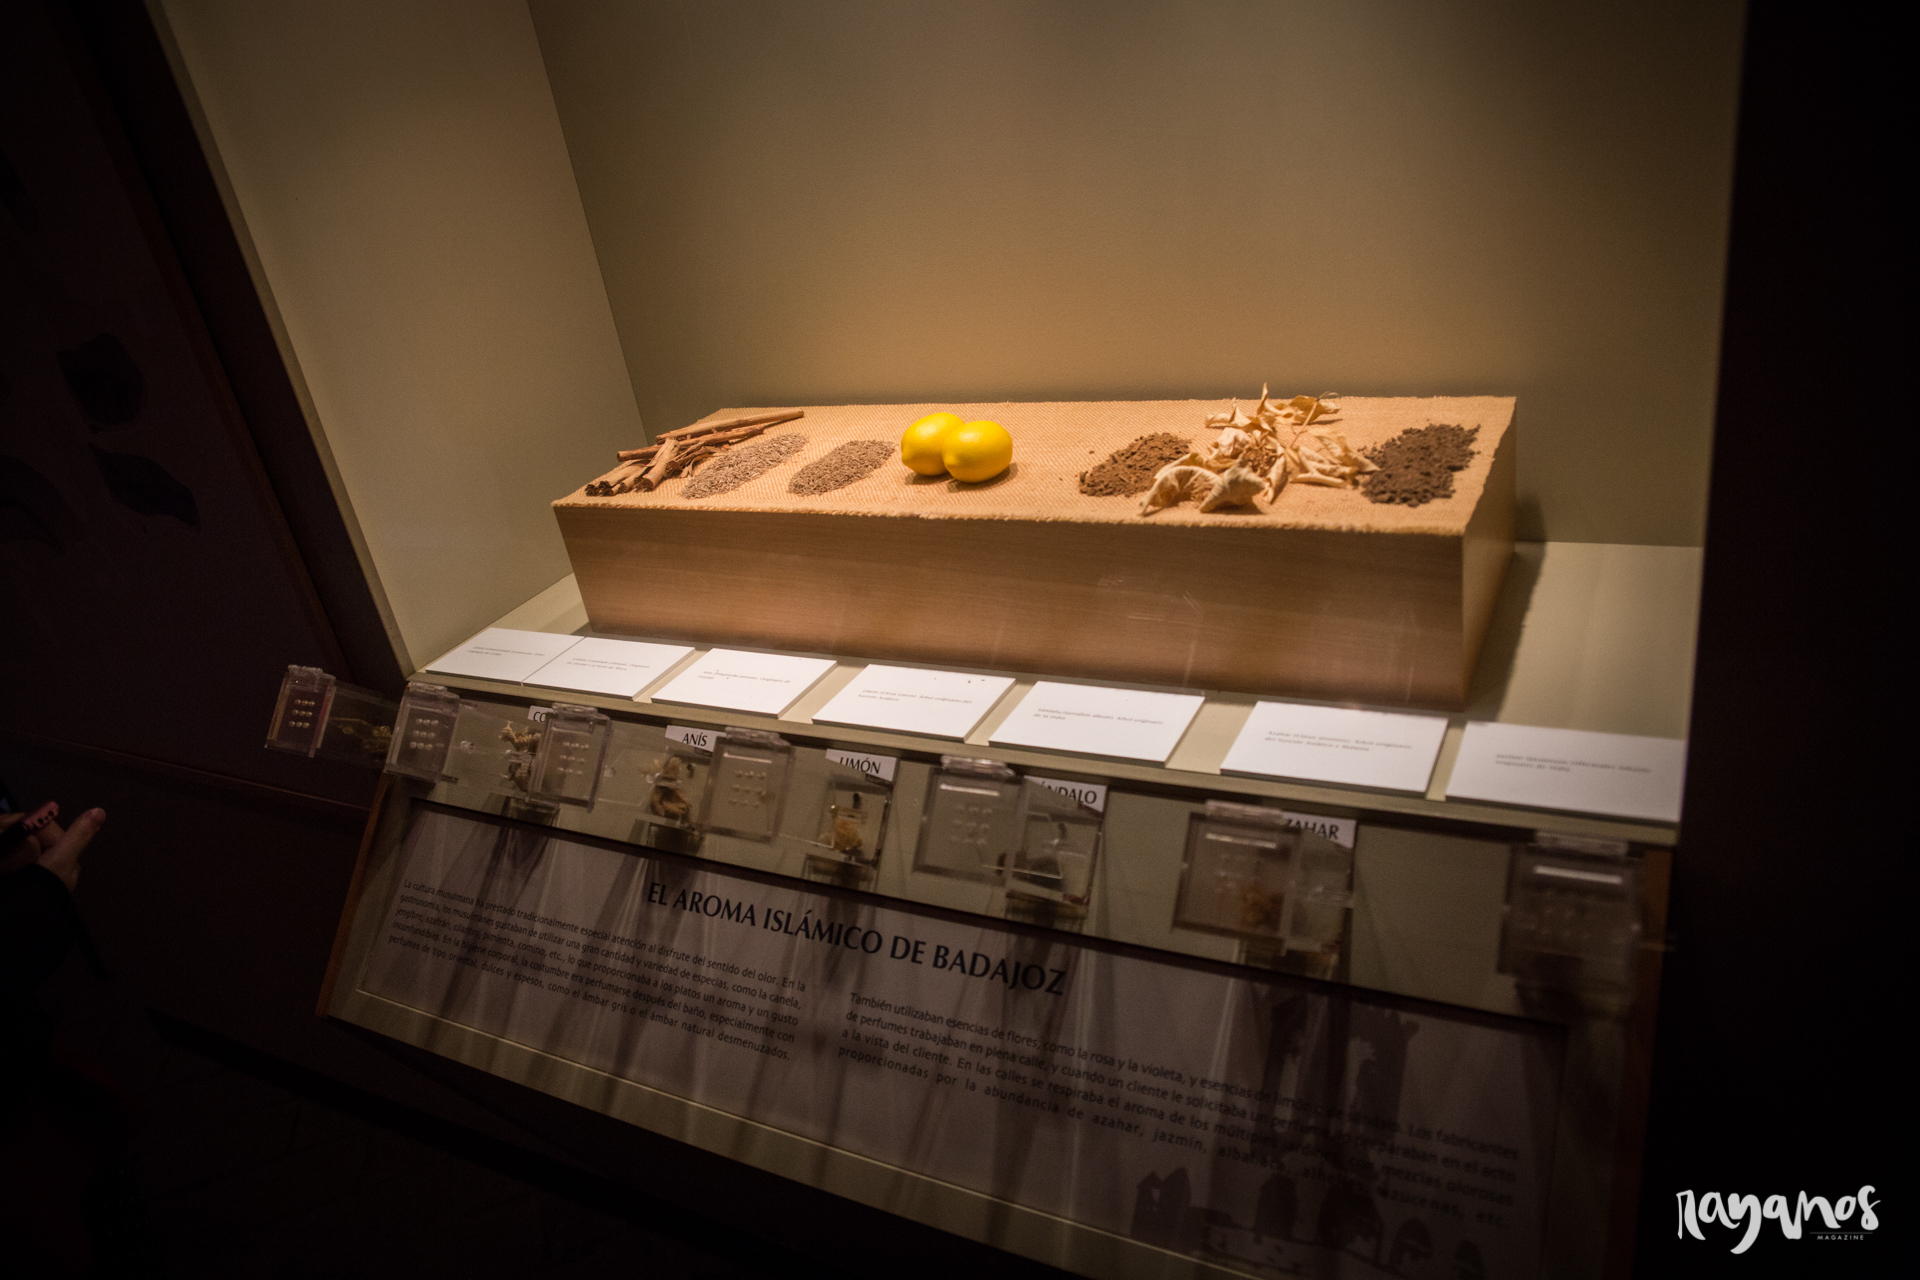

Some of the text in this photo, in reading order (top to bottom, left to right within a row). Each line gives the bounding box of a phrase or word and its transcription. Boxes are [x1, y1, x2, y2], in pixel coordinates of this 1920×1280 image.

[682, 732, 708, 746] ANÍS
[392, 919, 440, 940] inconfundibles.
[442, 934, 450, 943] En
[454, 936, 458, 946] la
[487, 948, 518, 966] corporal,
[520, 956, 527, 966] la
[530, 961, 568, 979] costumbre
[571, 973, 582, 983] era
[585, 977, 630, 996] perfumarse
[632, 989, 664, 1006] después
[667, 999, 680, 1011] del
[682, 1003, 706, 1020] baño,
[710, 1013, 774, 1037] especialmente
[776, 1031, 794, 1042] con
[395, 905, 422, 922] jengibre,
[425, 915, 450, 930] azafrán,
[482, 931, 514, 949] pimienta,
[518, 942, 546, 958] comino,
[548, 950, 564, 963] etc.,
[567, 954, 574, 964] lo
[576, 958, 590, 968] que
[592, 963, 650, 985] proporcionaba
[660, 979, 672, 991] los
[674, 984, 700, 999] platos
[703, 993, 714, 1002] un
[716, 997, 745, 1011] aroma
[748, 1006, 754, 1016] y
[756, 1008, 768, 1017] un
[771, 1012, 798, 1025] gusto
[400, 894, 800, 1011] gastronomía, los musulmanes gustaban de utilizar una gran cantidad y variedad de especias, como la canela,
[403, 879, 804, 991] La cultura musulmana ha prestado tradicionalmente especial atención al disfrute del sentido del olor. En la
[648, 882, 1066, 995] EL AROMA ISLÁMICO DE BADAJOZ
[388, 935, 419, 949] perfumes
[421, 943, 430, 952] de
[432, 946, 446, 959] tipo
[480, 961, 503, 975] dulces
[506, 970, 510, 980] y
[513, 972, 544, 989] espesos,
[547, 982, 570, 995] como
[572, 989, 580, 998] el
[582, 991, 608, 1006] ámbar
[611, 1001, 626, 1012] gris
[638, 1008, 647, 1018] el
[650, 1010, 678, 1026] ámbar
[681, 1021, 714, 1037] natural
[718, 1030, 789, 1059] desmenuzados.
[850, 991, 891, 1011] También
[894, 1005, 943, 1024] utilizaban
[946, 1018, 988, 1036] esencias
[991, 1027, 1004, 1039] de
[1006, 1031, 1040, 1051] flores,
[1042, 1042, 1074, 1056] como
[1078, 1048, 1086, 1060] la
[1090, 1053, 1114, 1066] rosa
[1117, 1060, 1124, 1072] y
[1127, 1060, 1138, 1072] la
[1140, 1064, 1185, 1085] violeta,
[1189, 1076, 1196, 1088] y
[838, 1047, 928, 1078] proporcionadas
[936, 1073, 956, 1086] por
[964, 1079, 975, 1091] la
[984, 1086, 1058, 1113] abundancia
[1067, 1107, 1083, 1120] de
[1092, 1115, 1142, 1138] azahar,
[1151, 1128, 1206, 1154] jazmín,
[842, 1029, 848, 1038] a
[852, 1029, 860, 1041] la
[864, 1034, 888, 1048] vista
[892, 1040, 908, 1054] del
[912, 1047, 951, 1065] cliente.
[957, 1057, 971, 1070] En
[976, 1061, 990, 1075] las
[995, 1069, 1026, 1084] calles
[1031, 1078, 1042, 1088] se
[1048, 1083, 1103, 1104] respiraba
[1108, 1098, 1120, 1108] el
[1122, 1102, 1164, 1119] aroma
[1169, 1112, 1184, 1124] de
[1190, 1116, 1208, 1130] los
[846, 1009, 857, 1022] de
[860, 1015, 907, 1035] perfumes
[910, 1027, 966, 1050] trabajaban
[969, 1043, 982, 1054] en
[984, 1046, 1015, 1062] plena
[1018, 1056, 1046, 1073] calle,
[1050, 1064, 1058, 1076] y
[1061, 1066, 1104, 1084] cuando
[1107, 1078, 1122, 1088] un
[1126, 1082, 1168, 1100] cliente
[1171, 1091, 1183, 1103] le
[1441, 1158, 1459, 1169] en
[1464, 1163, 1477, 1173] el
